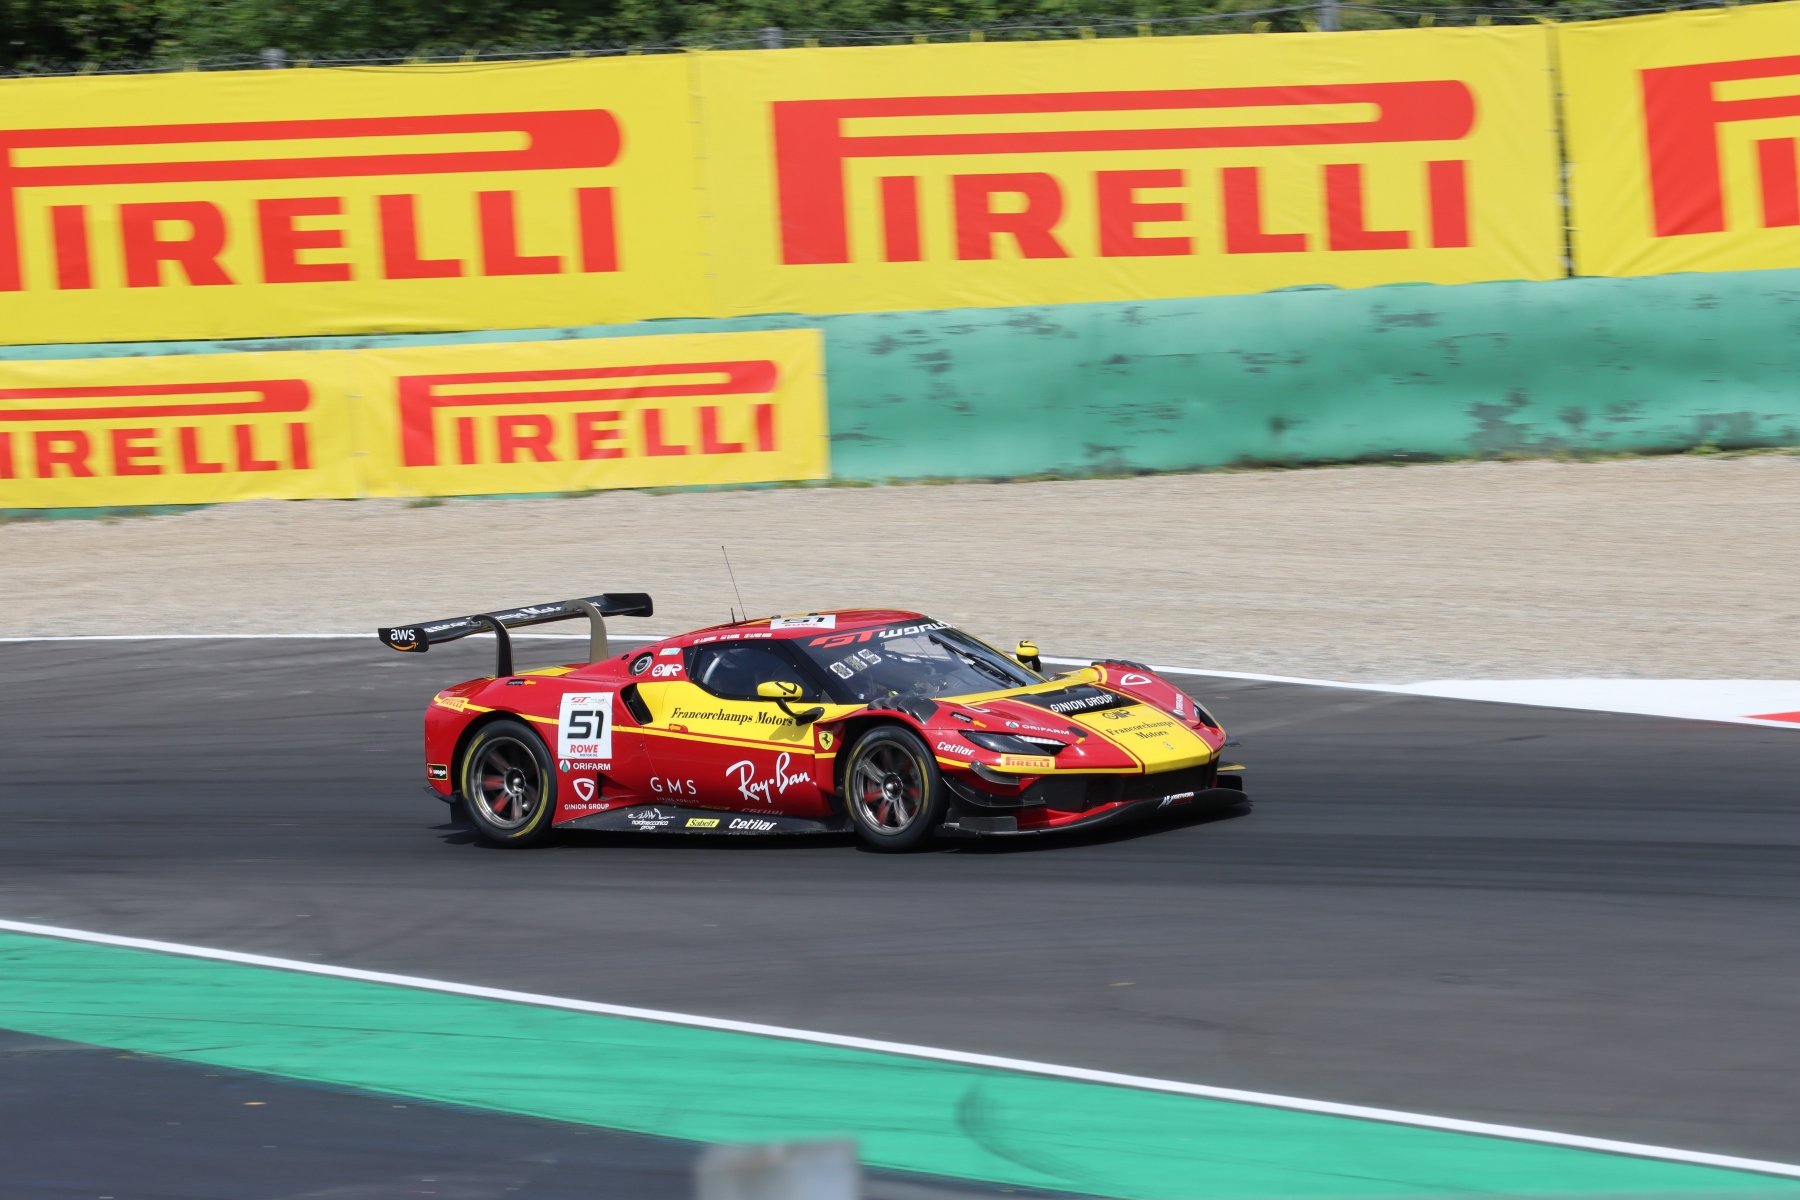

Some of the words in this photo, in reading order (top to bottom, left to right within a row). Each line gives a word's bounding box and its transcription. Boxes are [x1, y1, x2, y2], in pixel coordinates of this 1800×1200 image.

[772, 79, 1477, 265] PIRELLI
[0, 109, 623, 292] PIRELLI
[396, 360, 779, 467] PIRELLI
[390, 629, 416, 641] aws
[808, 628, 887, 649] GT
[1050, 698, 1087, 713] GINION
[1085, 694, 1113, 706] GROUP
[670, 708, 753, 724] Francorchamps
[755, 711, 793, 726] Motors
[567, 710, 604, 739] 51
[1022, 724, 1070, 735] ORIFARM
[1135, 730, 1169, 739] Motors
[570, 744, 599, 753] ROWE
[937, 741, 976, 756] Cetilar
[573, 763, 611, 771] ORIFARM
[1005, 757, 1050, 768] PIRELLI
[689, 819, 716, 827] Sabelt
[729, 818, 777, 831] Cetilar
